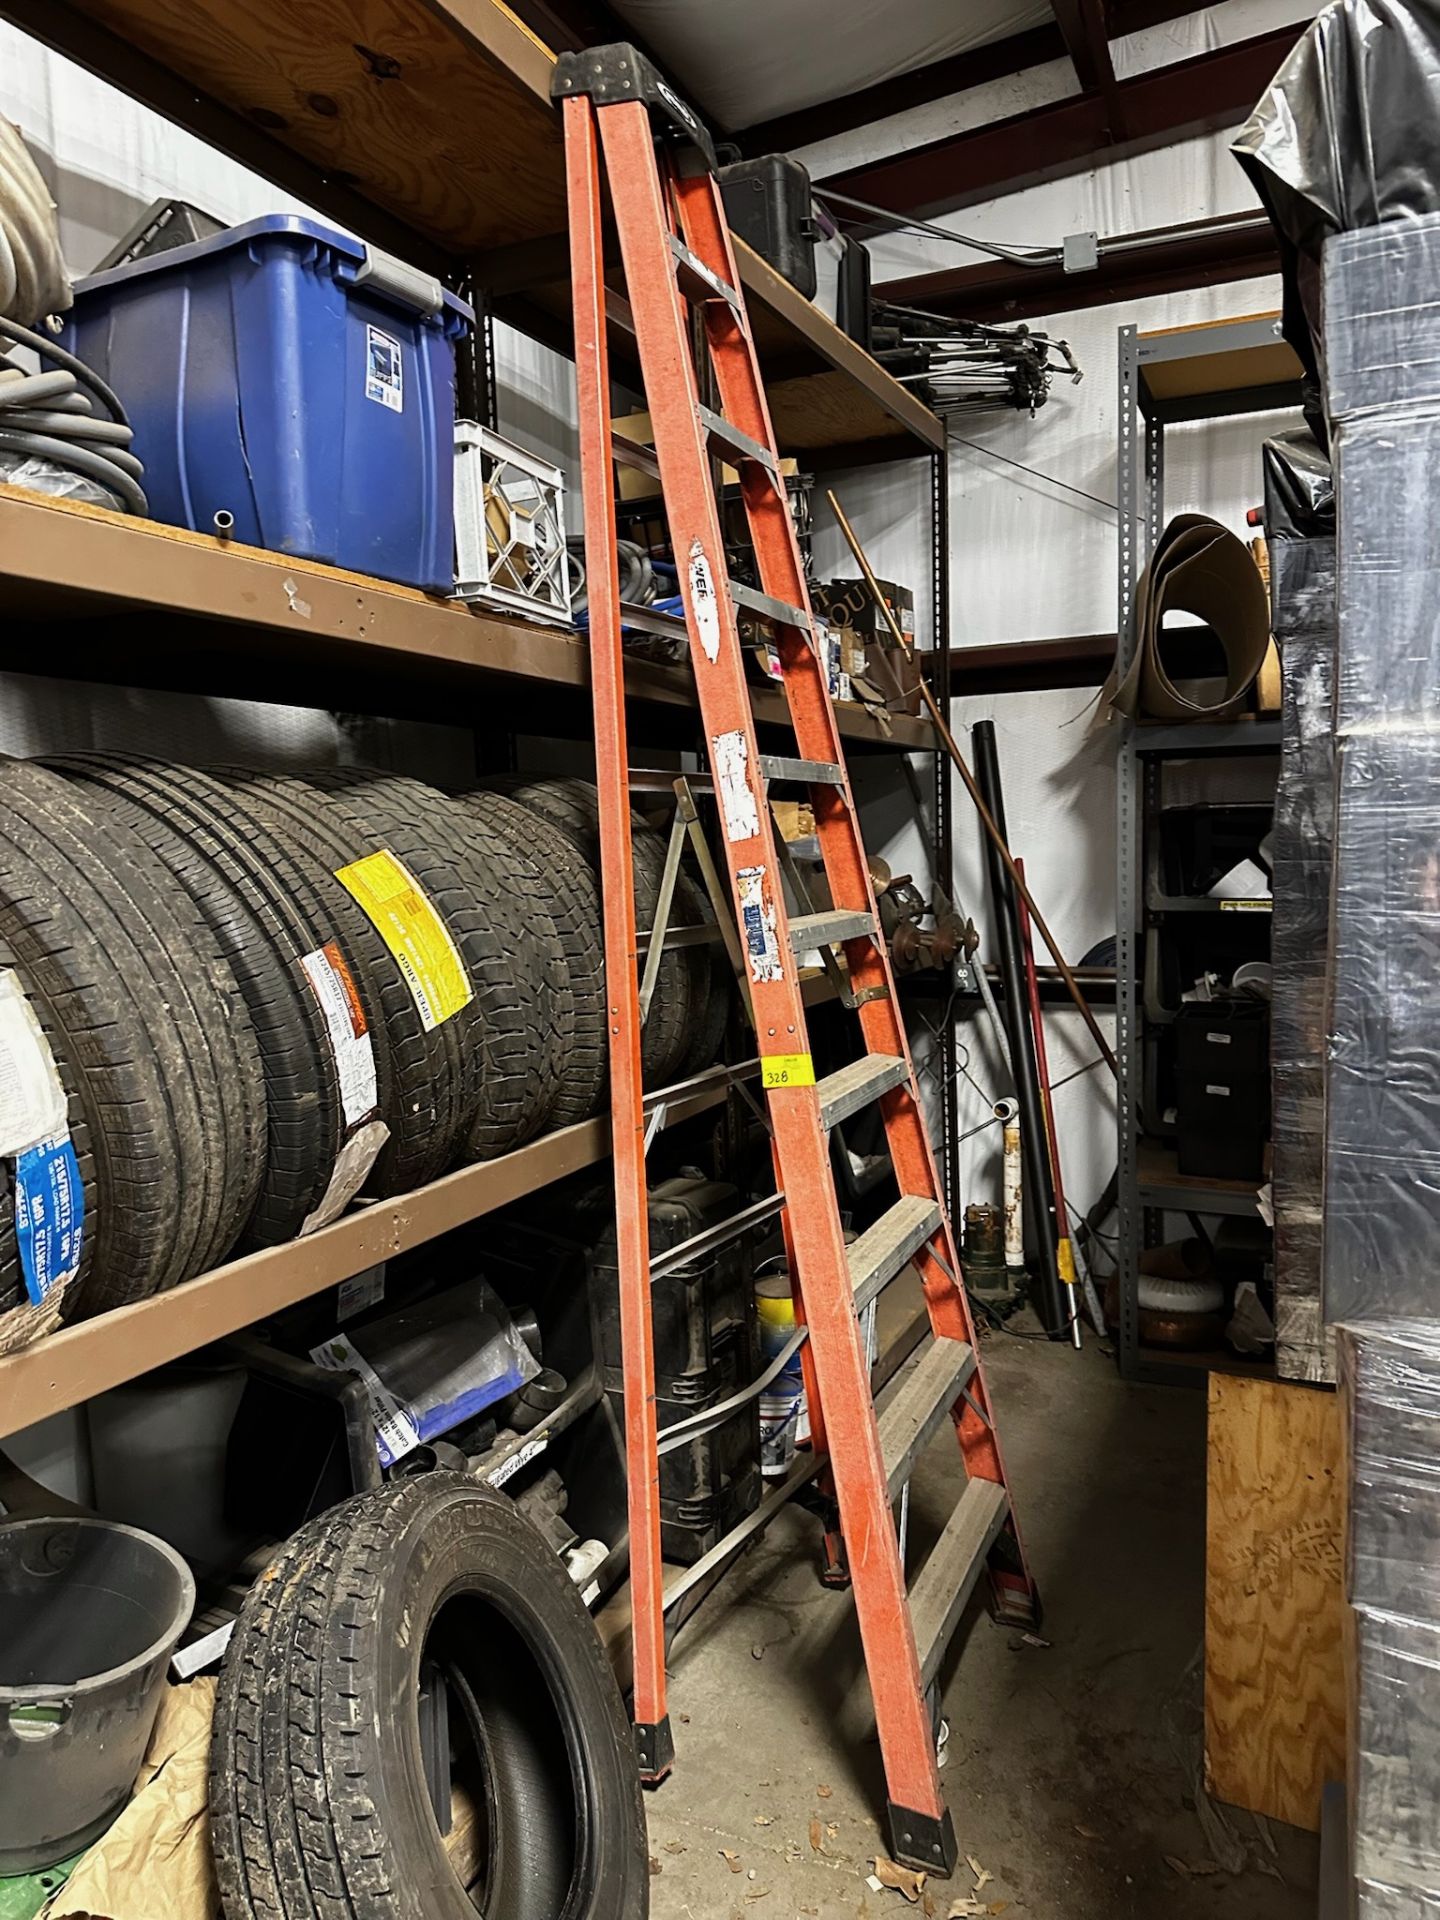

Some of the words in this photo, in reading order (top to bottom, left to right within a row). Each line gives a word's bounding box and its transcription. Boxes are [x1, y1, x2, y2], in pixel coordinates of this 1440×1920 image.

[330, 947, 367, 1031] THUNDERER
[767, 1070, 788, 1085] 328
[32, 1194, 45, 1225] 16PR
[374, 1396, 387, 1412] Filter
[385, 1411, 398, 1430] Basin
[395, 1429, 409, 1447] Catch
